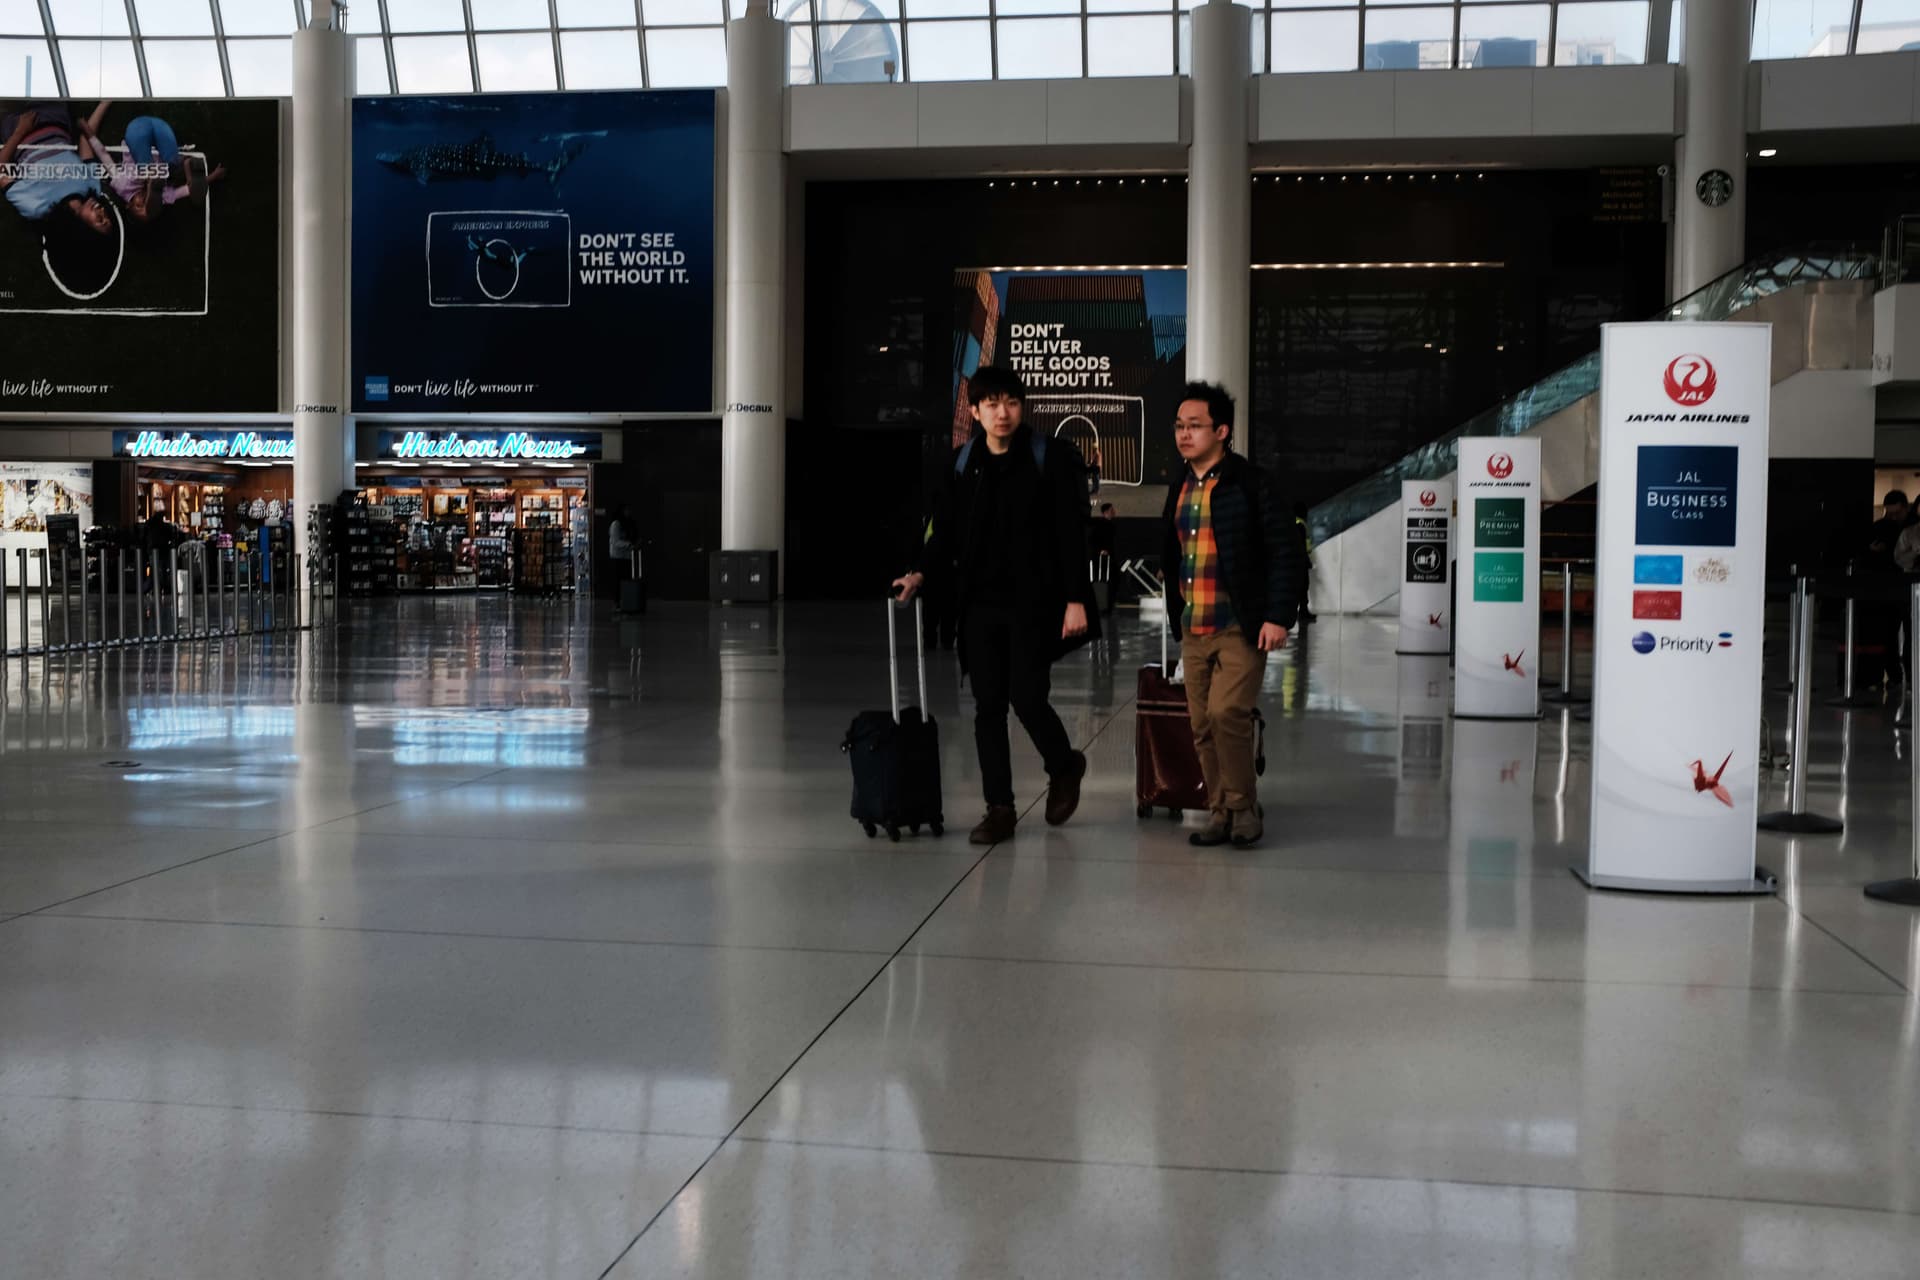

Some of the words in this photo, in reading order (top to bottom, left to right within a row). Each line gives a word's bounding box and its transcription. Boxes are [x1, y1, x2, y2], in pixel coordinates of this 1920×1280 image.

[0, 163, 87, 180] AMERICAN
[92, 163, 170, 179] EXPRESS
[580, 233, 636, 249] DON'T
[640, 233, 675, 248] SEE
[579, 251, 615, 266] THE
[619, 251, 685, 266] WORLD
[580, 269, 664, 285] WITHOUT
[670, 269, 690, 284] IT.
[1010, 324, 1064, 338] DON'T
[1010, 340, 1081, 354] DELIVER
[1010, 356, 1044, 370] THE
[1048, 356, 1111, 371] GOODS
[1094, 372, 1114, 387] IT.
[2, 379, 29, 397] live
[30, 378, 54, 398] life
[56, 384, 98, 393] WITHOUT
[394, 384, 423, 394] DON'T
[424, 379, 451, 396] live
[454, 378, 478, 398] life
[479, 384, 523, 393] WITHOUT
[1677, 391, 1706, 401] JAL
[1625, 414, 1677, 423] JAPAN
[1679, 414, 1751, 424] AIRLINES
[126, 431, 229, 457] Hudson
[228, 432, 294, 457] News
[392, 432, 500, 458] Hudson
[498, 433, 587, 459] News
[1676, 471, 1702, 483] JAL
[1647, 491, 1728, 508] BUSINESS
[1671, 509, 1704, 520] CLASS
[1479, 520, 1520, 529] PREMIUM
[1478, 575, 1520, 584] ECONOMY
[1660, 636, 1714, 654] Priority
